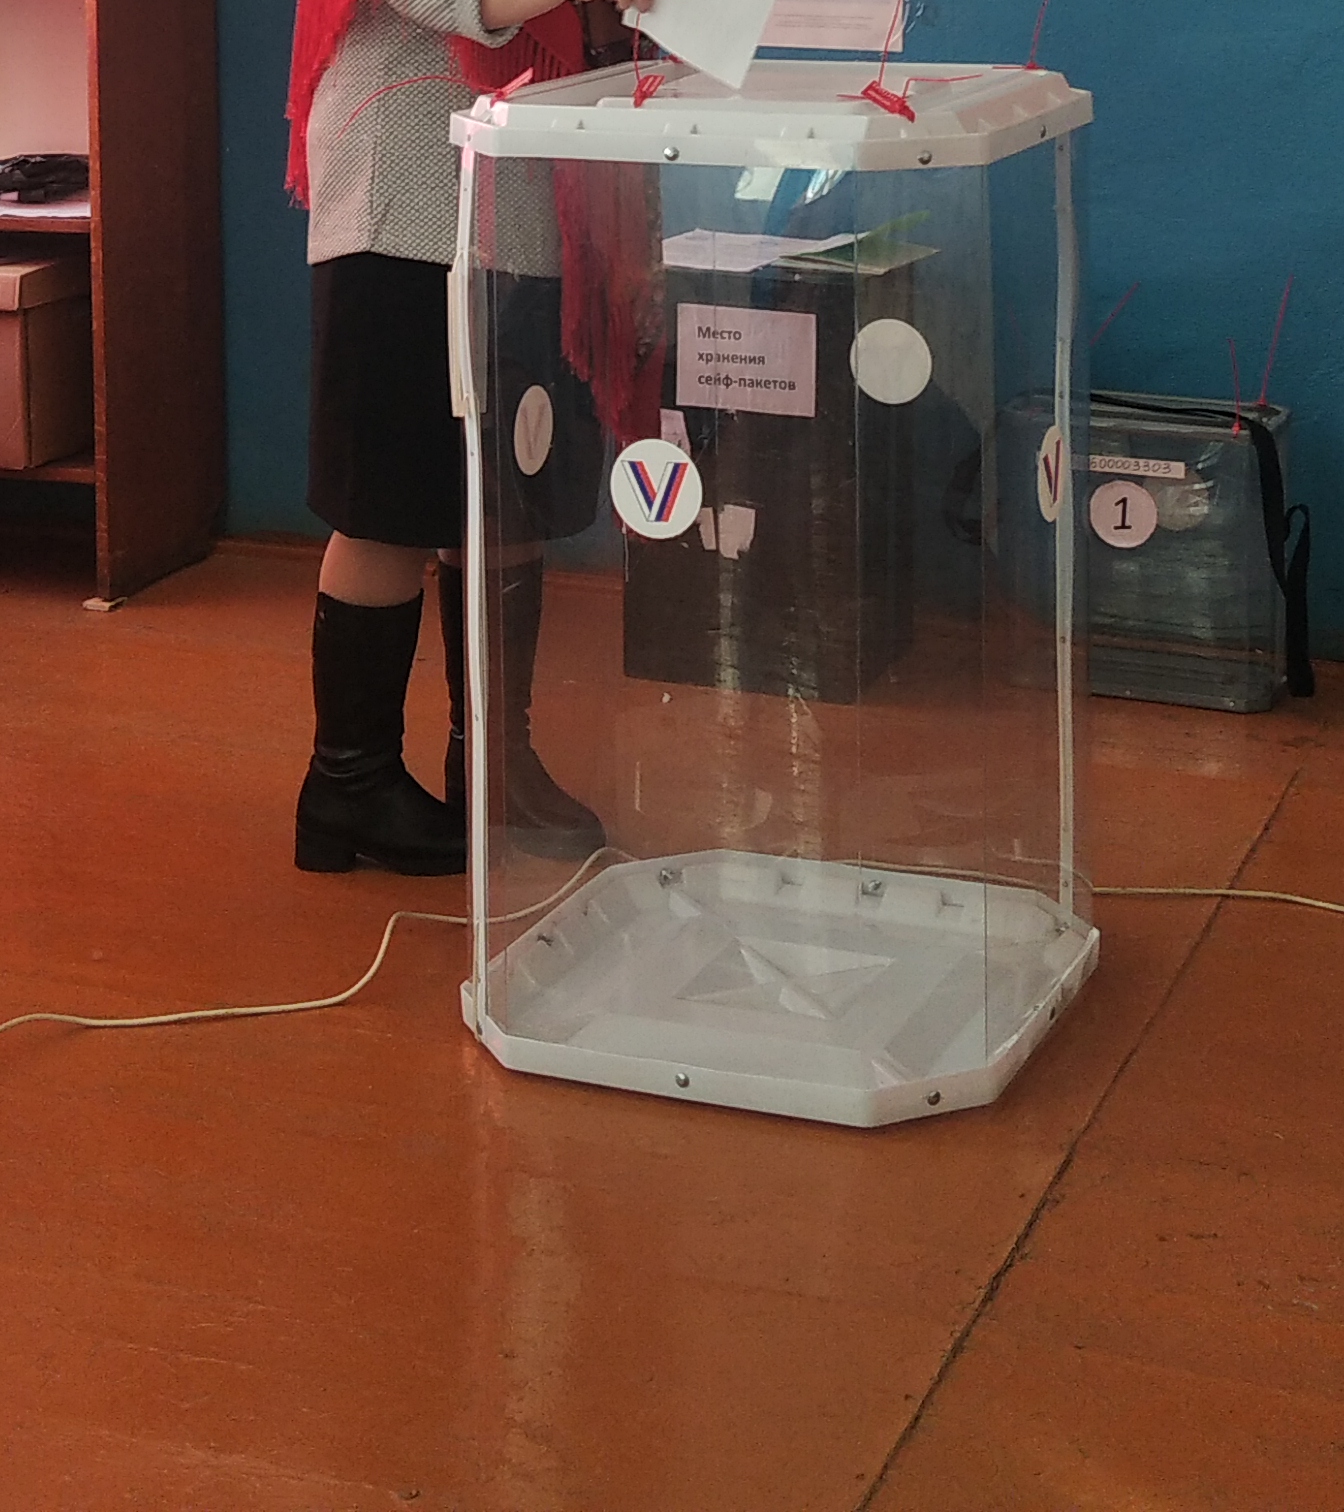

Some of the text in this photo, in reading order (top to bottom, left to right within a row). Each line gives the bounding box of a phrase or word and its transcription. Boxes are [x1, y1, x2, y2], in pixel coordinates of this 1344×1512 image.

[696, 326, 743, 341] Место
[697, 350, 766, 367] хранения
[697, 373, 797, 392] сейф-пакетов
[1112, 495, 1133, 531] 1
